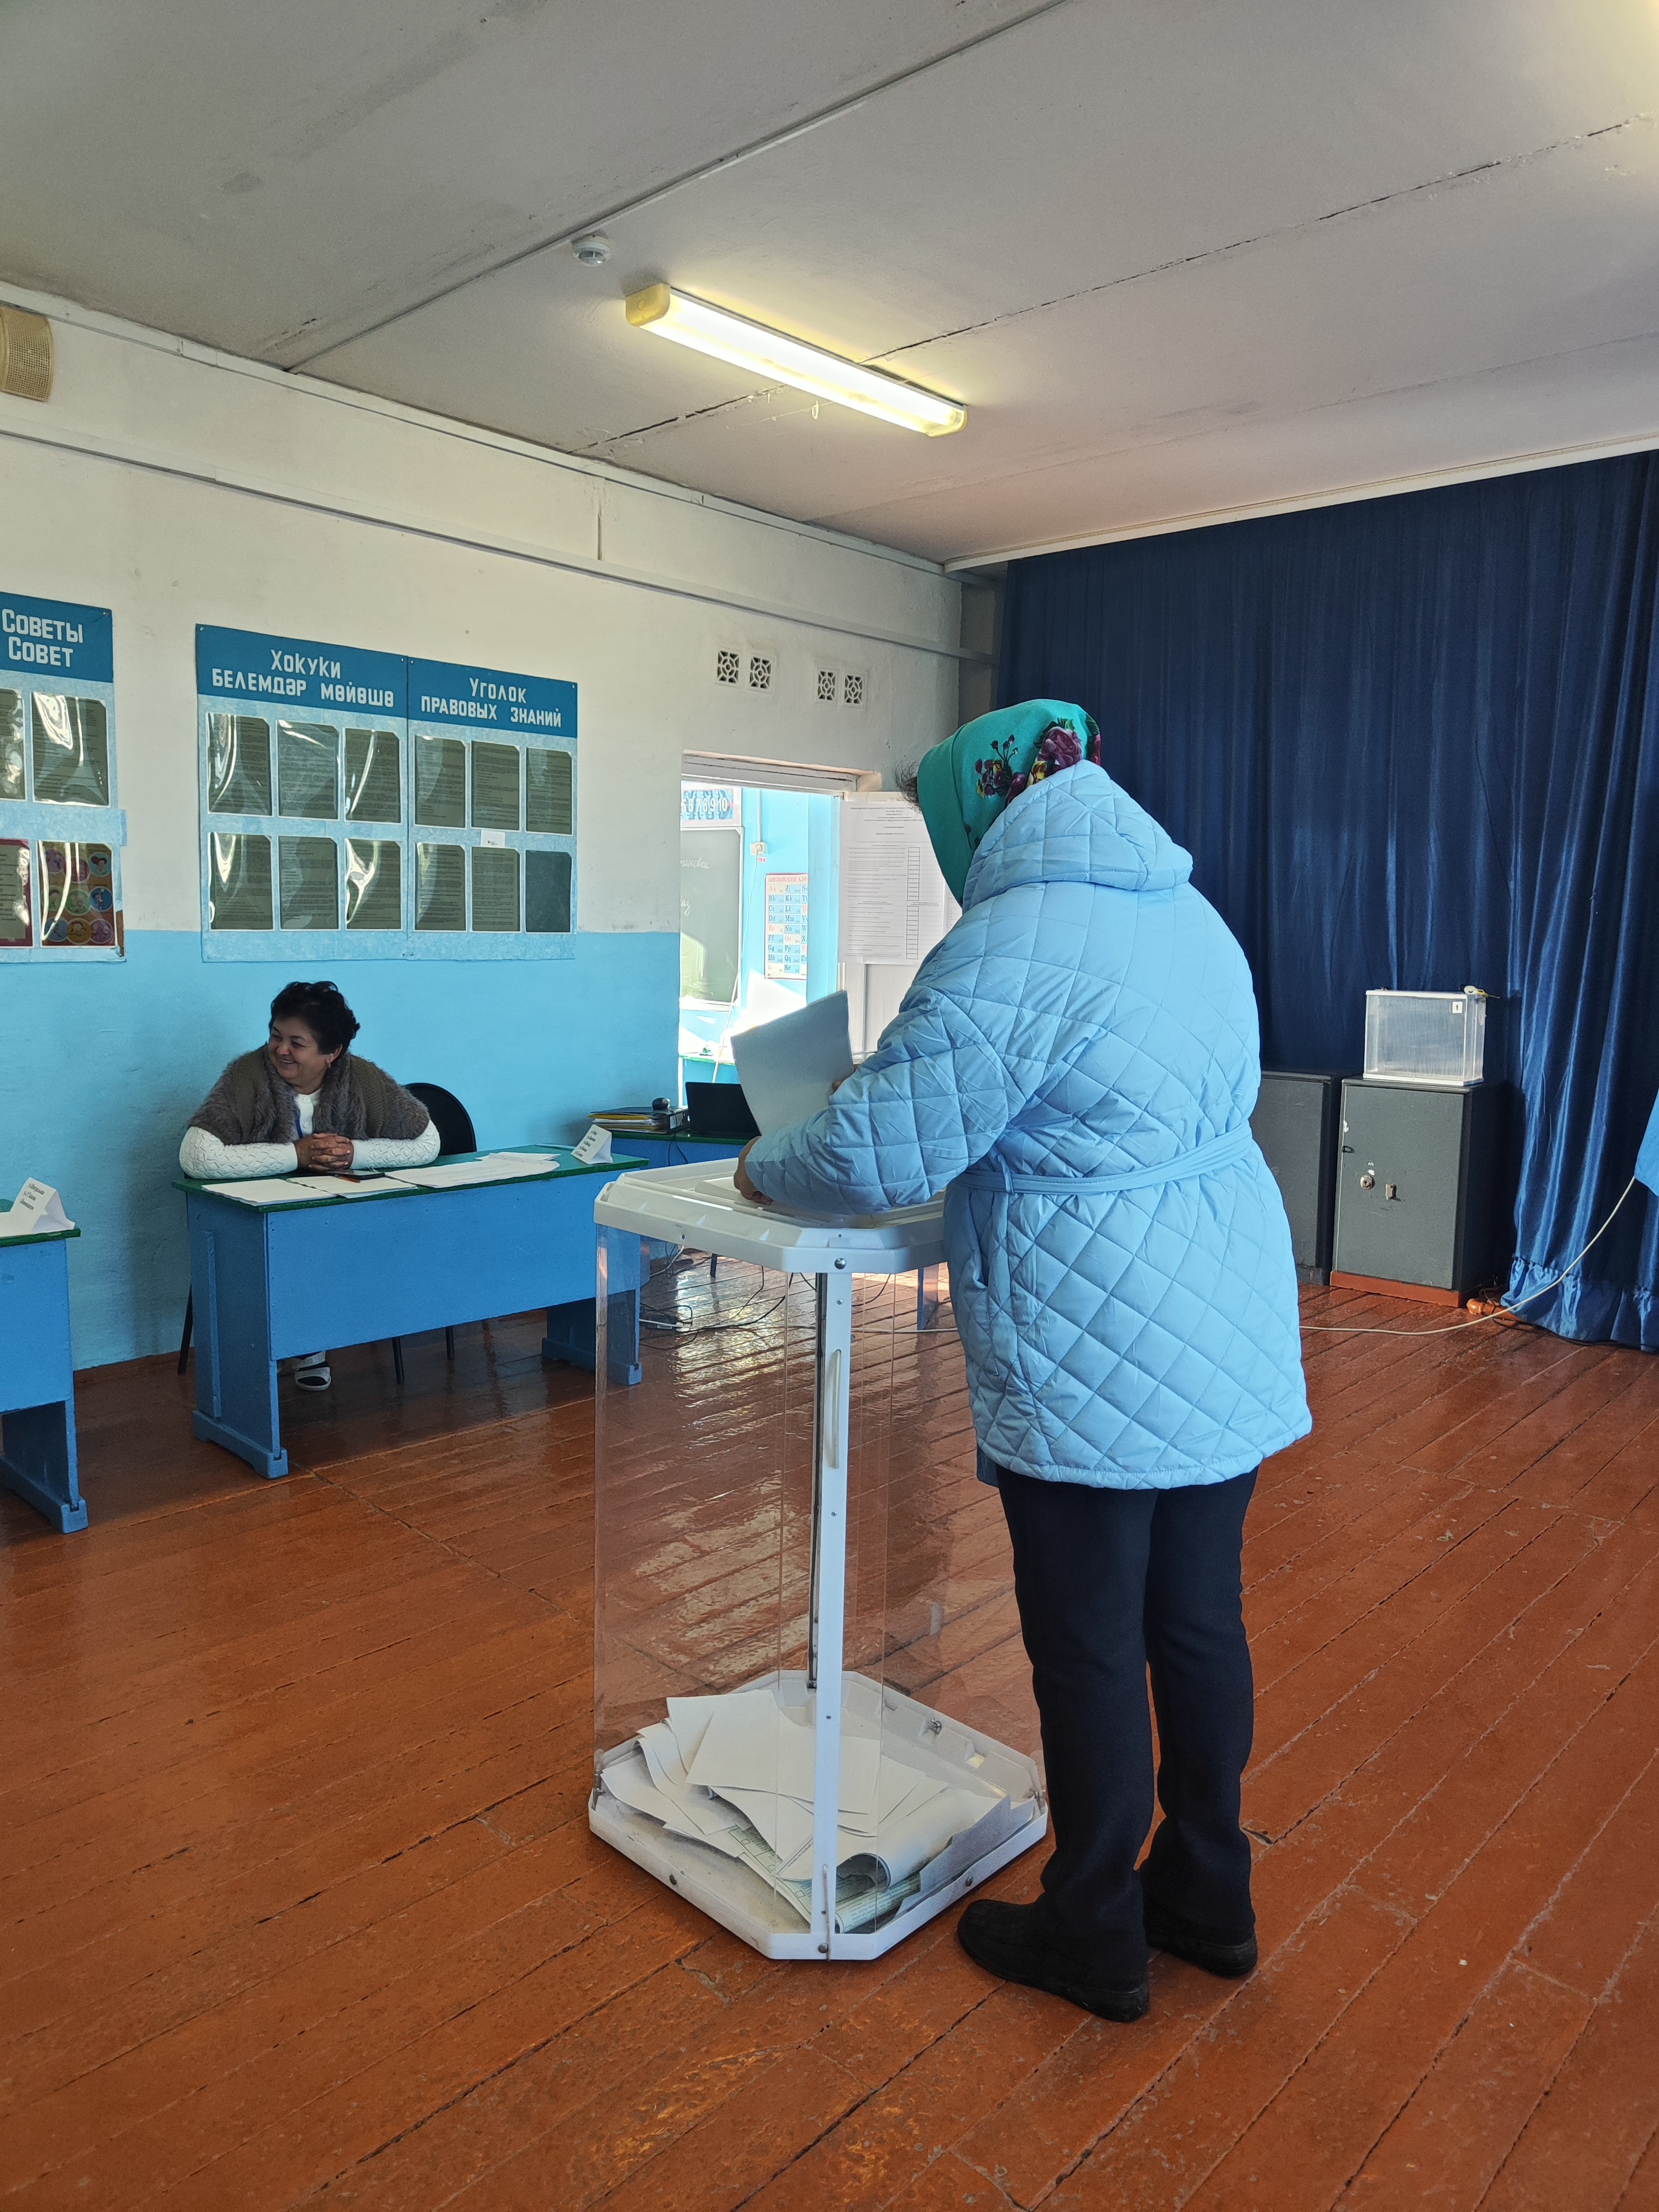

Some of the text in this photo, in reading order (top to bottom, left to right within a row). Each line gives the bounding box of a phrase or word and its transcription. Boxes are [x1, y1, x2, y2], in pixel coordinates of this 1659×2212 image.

[421, 695, 562, 728] ПРАВОВЫХ ЗНАНИЙ
[688, 799, 693, 812] 6
[696, 798, 701, 812] 7
[703, 798, 707, 812] 8
[711, 797, 716, 812] 9
[719, 797, 727, 811] 10
